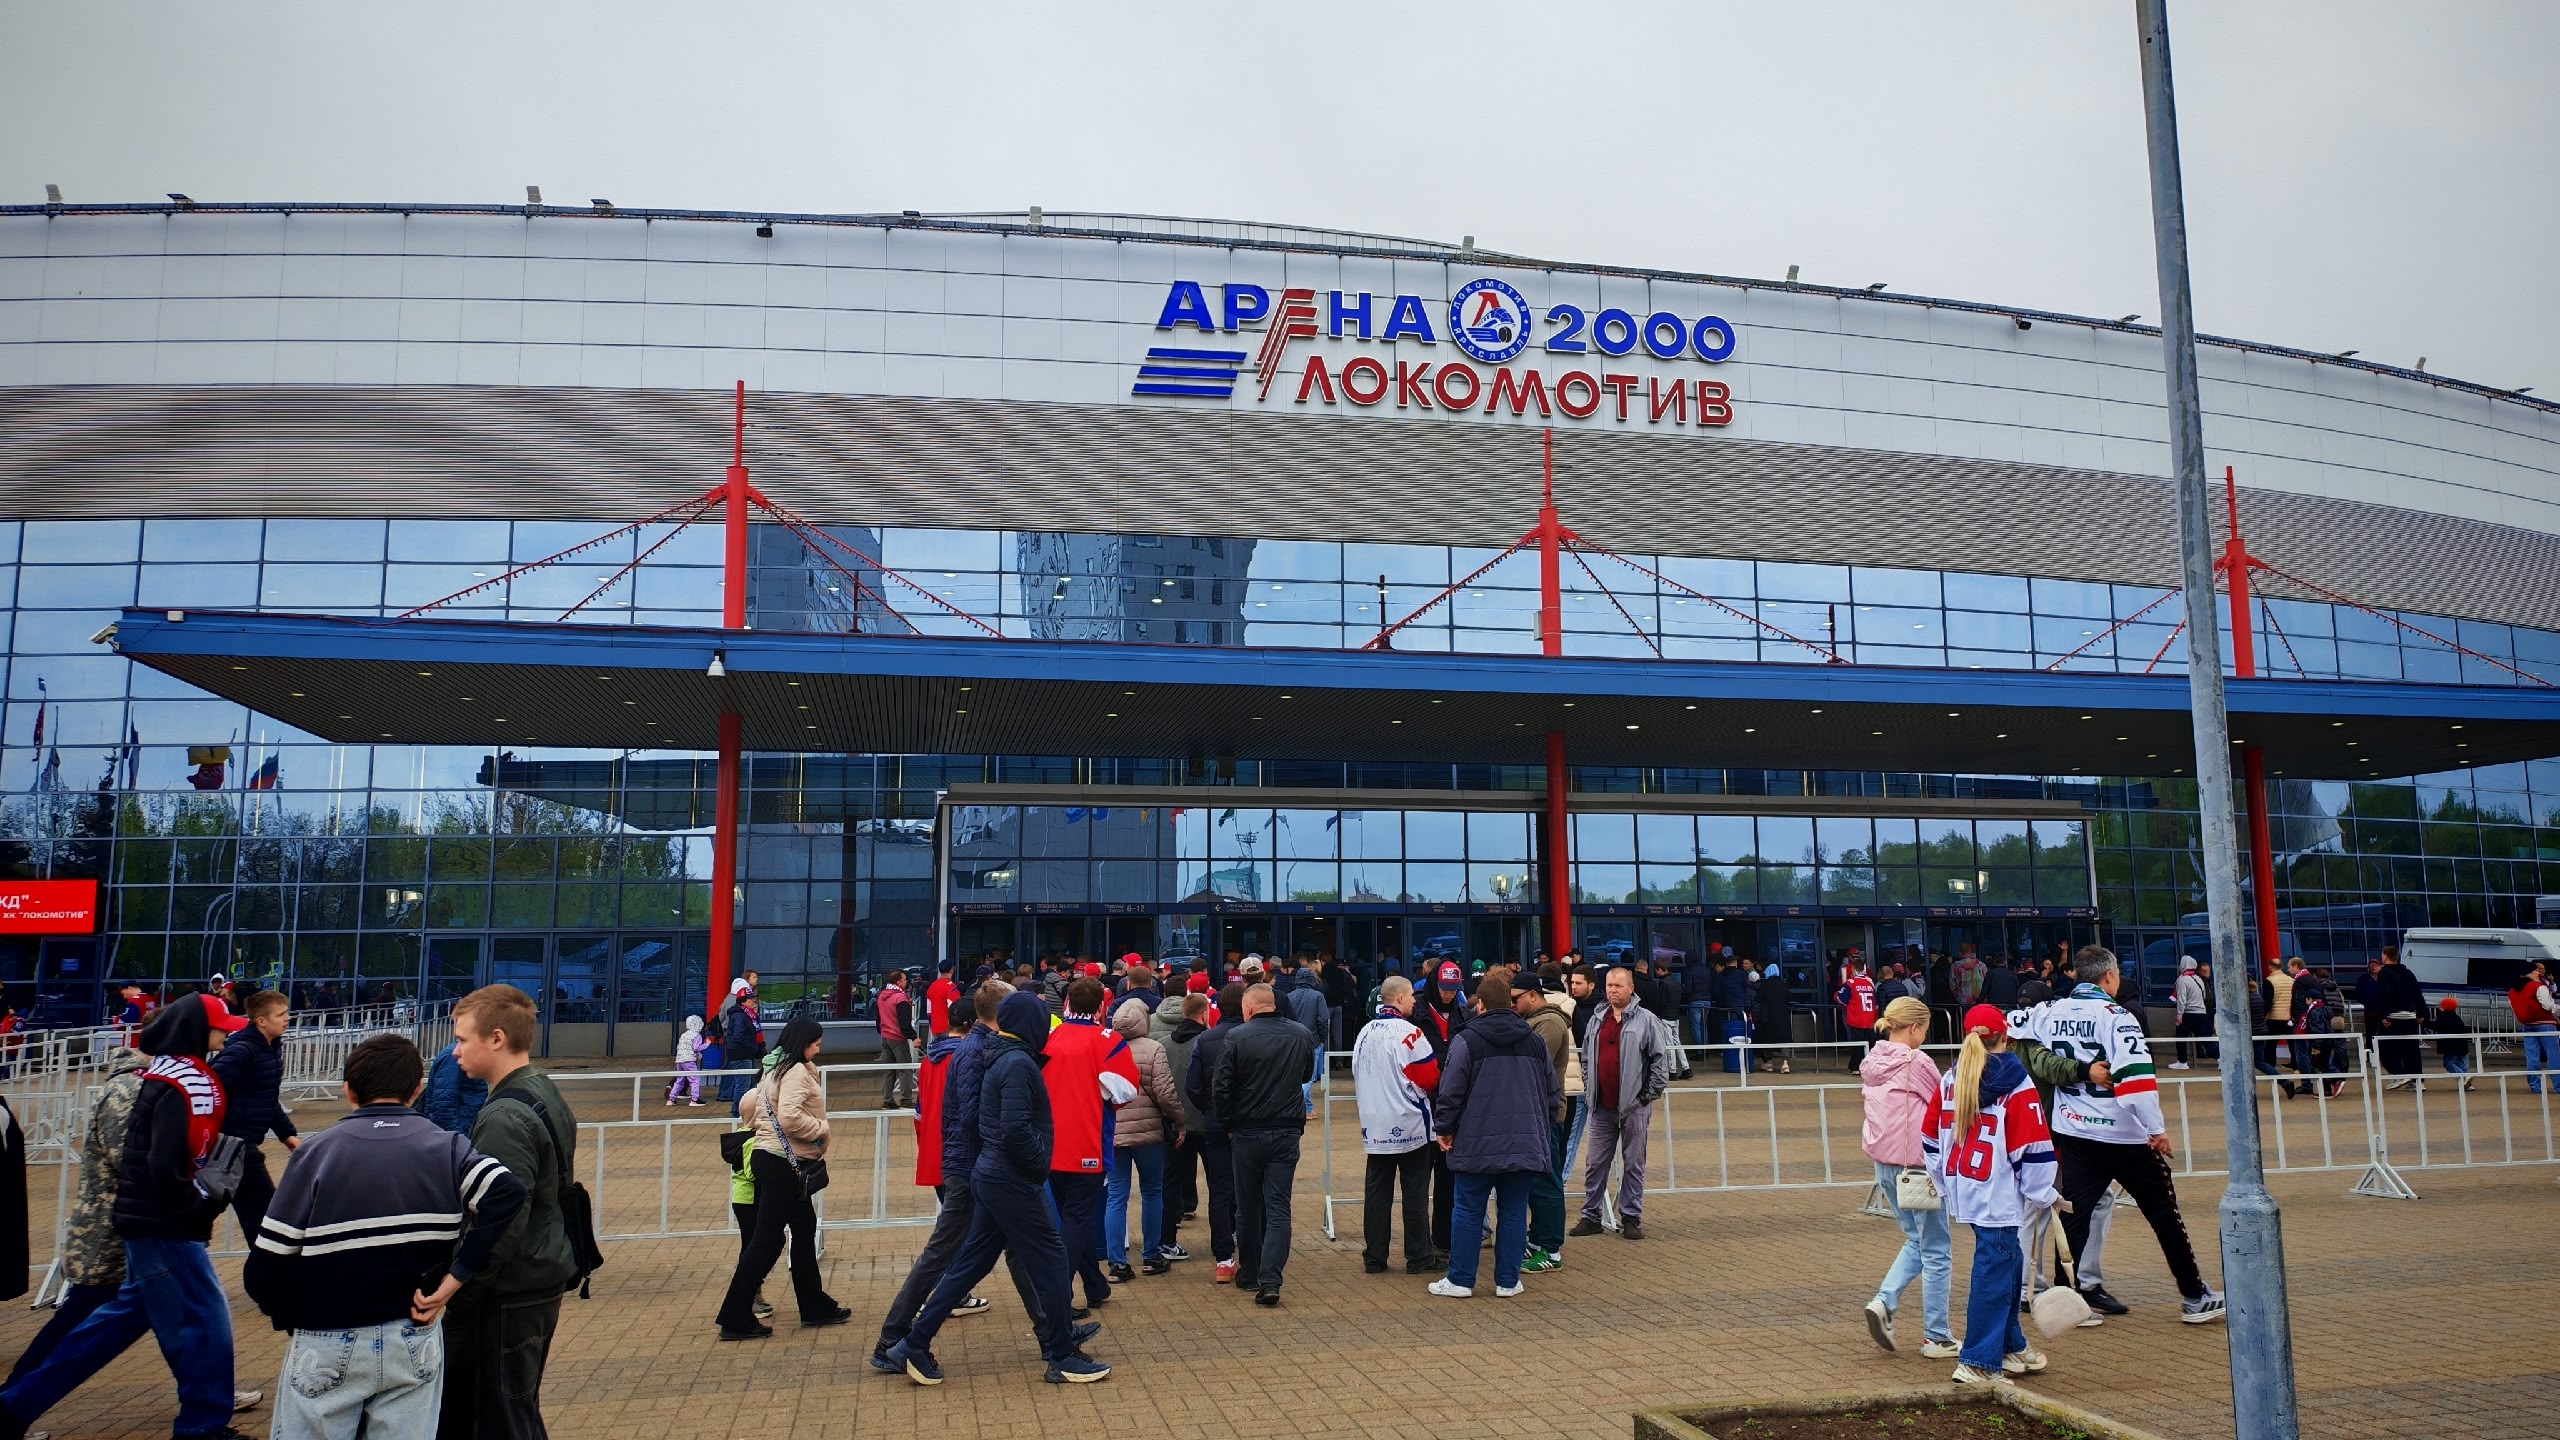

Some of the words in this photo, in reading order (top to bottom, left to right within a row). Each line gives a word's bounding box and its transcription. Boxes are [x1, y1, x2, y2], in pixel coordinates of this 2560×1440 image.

[1452, 279, 1528, 313] ЛОКОМОТИВ
[1155, 278, 1437, 350] АРЕНА
[1544, 303, 1737, 363] 2000
[1453, 327, 1529, 361] ЯРОСЛАВЛЬ
[1295, 354, 1736, 427] ЛОКОМОТИВ
[1126, 904, 1145, 913] 6-12
[1859, 992, 1873, 1012] 15
[2066, 1111, 2117, 1127] TATNEFT
[1940, 1109, 1998, 1182] 76
